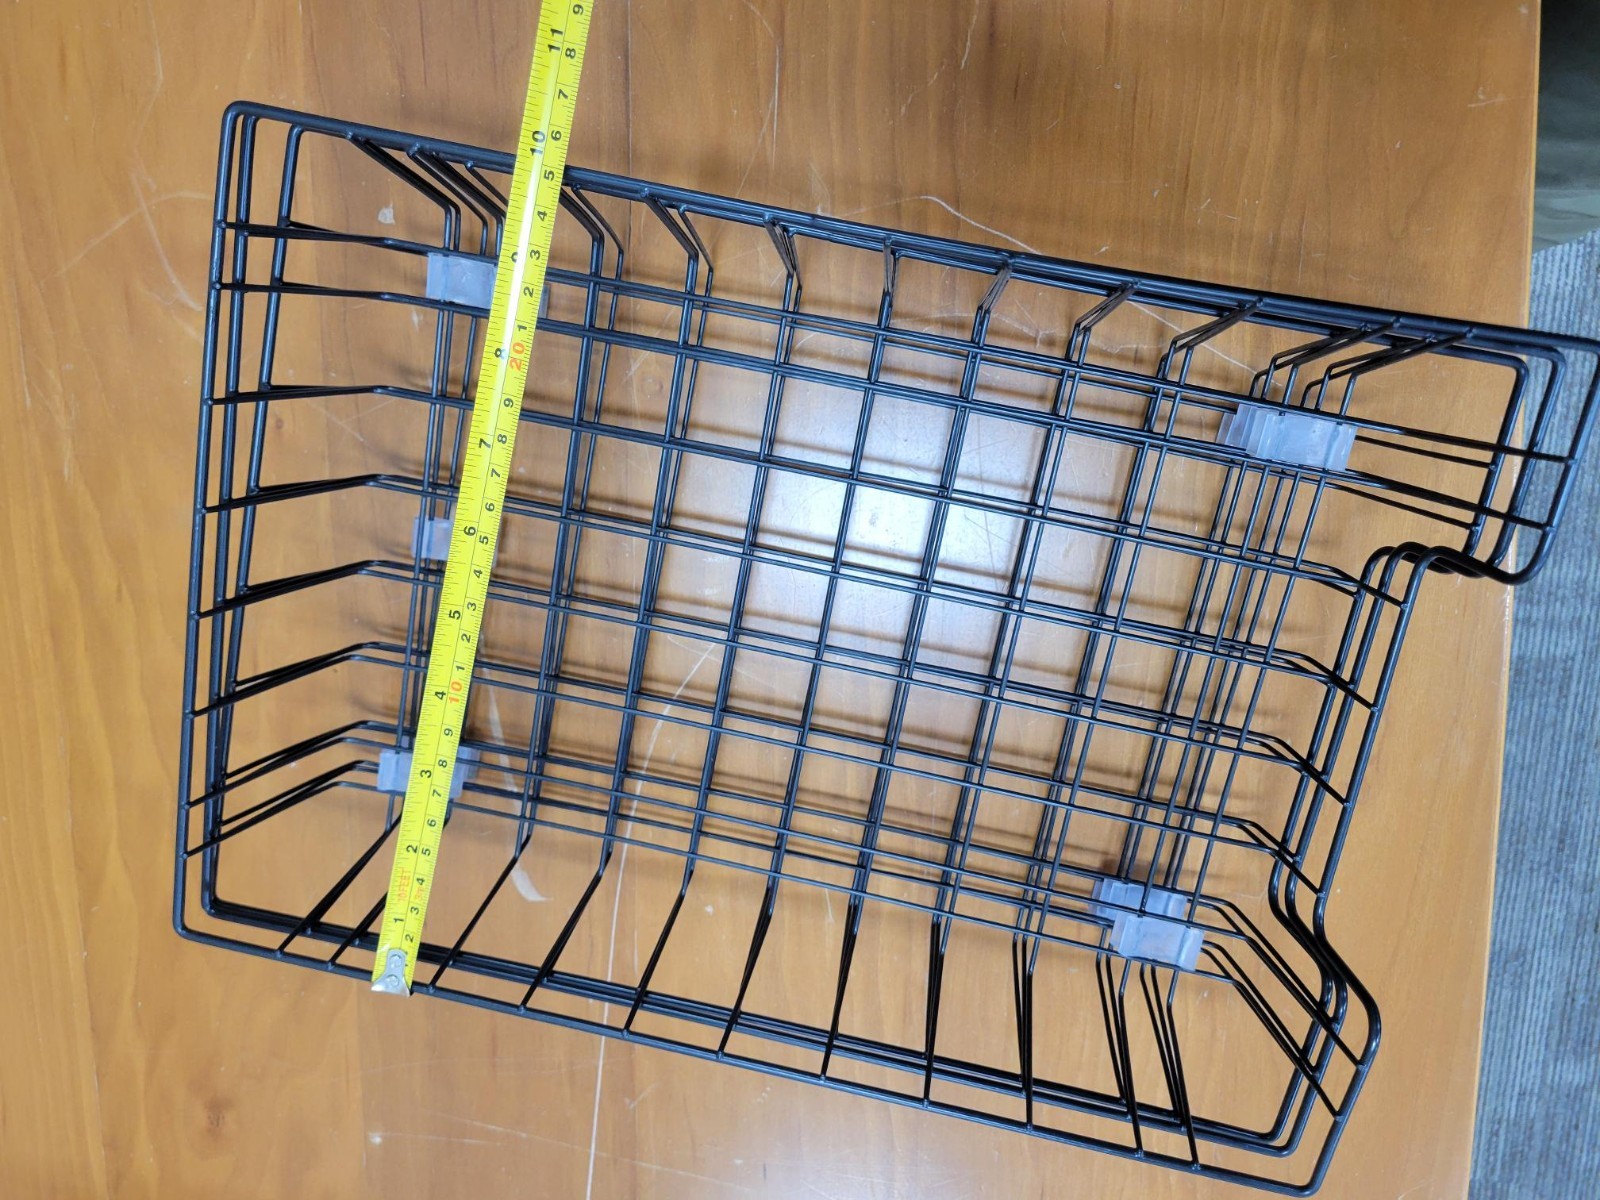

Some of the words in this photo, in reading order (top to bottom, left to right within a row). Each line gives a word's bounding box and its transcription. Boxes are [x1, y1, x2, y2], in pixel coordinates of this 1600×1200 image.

[572, 4, 584, 15] 9
[547, 28, 563, 52] 11
[565, 47, 576, 59] 8
[558, 89, 569, 100] 7
[551, 130, 562, 141] 6
[529, 130, 546, 156] 10
[544, 170, 555, 181] 5
[537, 210, 548, 222] 4
[530, 249, 541, 261] 3
[523, 286, 534, 298] 2
[516, 324, 527, 332] 1
[509, 342, 525, 372] 20
[503, 398, 514, 408] 9
[478, 438, 492, 449] 7
[497, 433, 508, 444] 8
[490, 468, 501, 478] 7
[485, 502, 495, 512] 6
[463, 525, 477, 537] 6
[478, 534, 489, 545] 5
[473, 569, 483, 579] 4
[466, 601, 477, 612] 3
[448, 609, 461, 620] 5
[461, 633, 472, 643] 2
[434, 690, 447, 700] 4
[448, 680, 463, 704] 10
[443, 727, 454, 737] 9
[438, 758, 448, 768] 8
[419, 769, 432, 779] 3
[432, 789, 442, 798] 7
[427, 818, 437, 828] 6
[405, 844, 419, 854] 2
[421, 847, 431, 857] 5
[416, 877, 425, 886] 4
[410, 906, 420, 915] 3
[405, 933, 414, 943] 2
